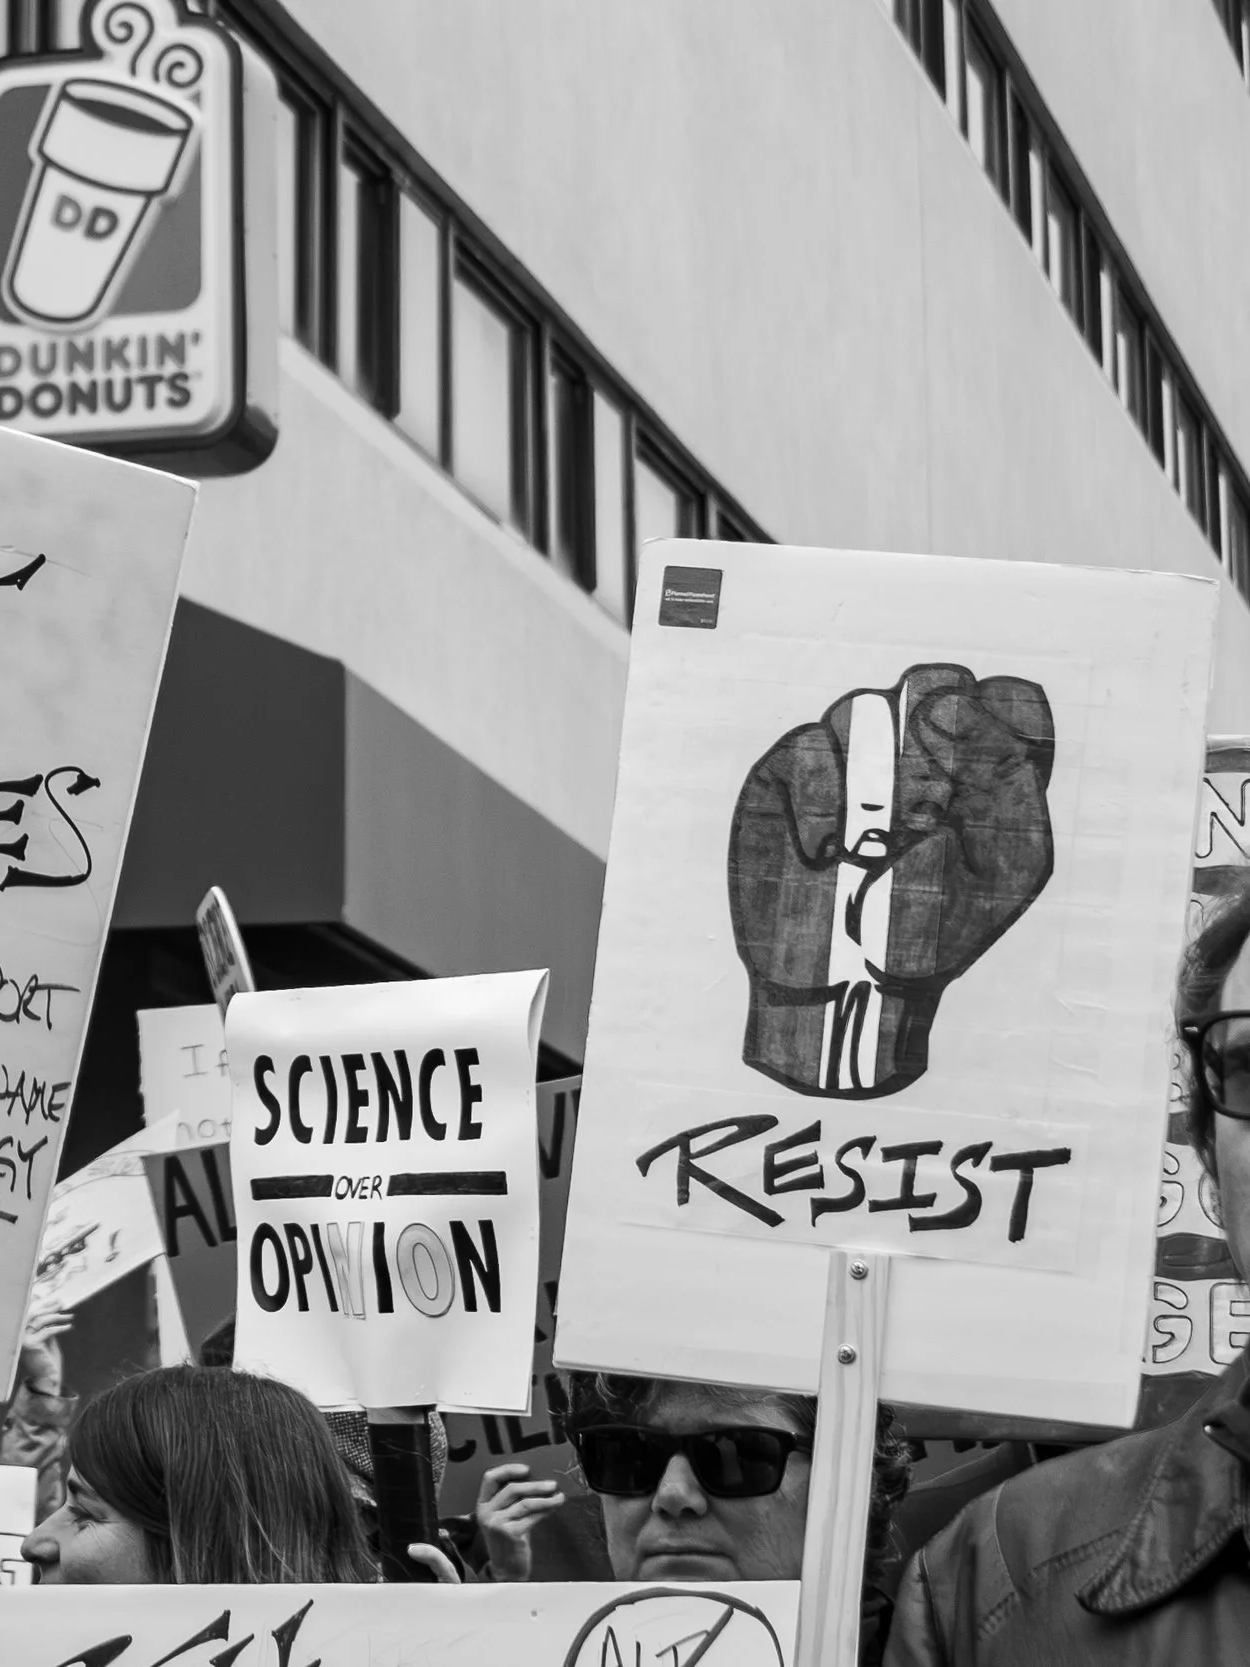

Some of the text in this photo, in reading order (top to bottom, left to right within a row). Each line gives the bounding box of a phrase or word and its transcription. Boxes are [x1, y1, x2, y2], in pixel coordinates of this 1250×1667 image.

[53, 195, 118, 240] DD
[253, 1047, 483, 1145] SCIENCE
[335, 1175, 384, 1201] OVER
[635, 1112, 1073, 1243] RESIST
[250, 1219, 502, 1319] OPINION
